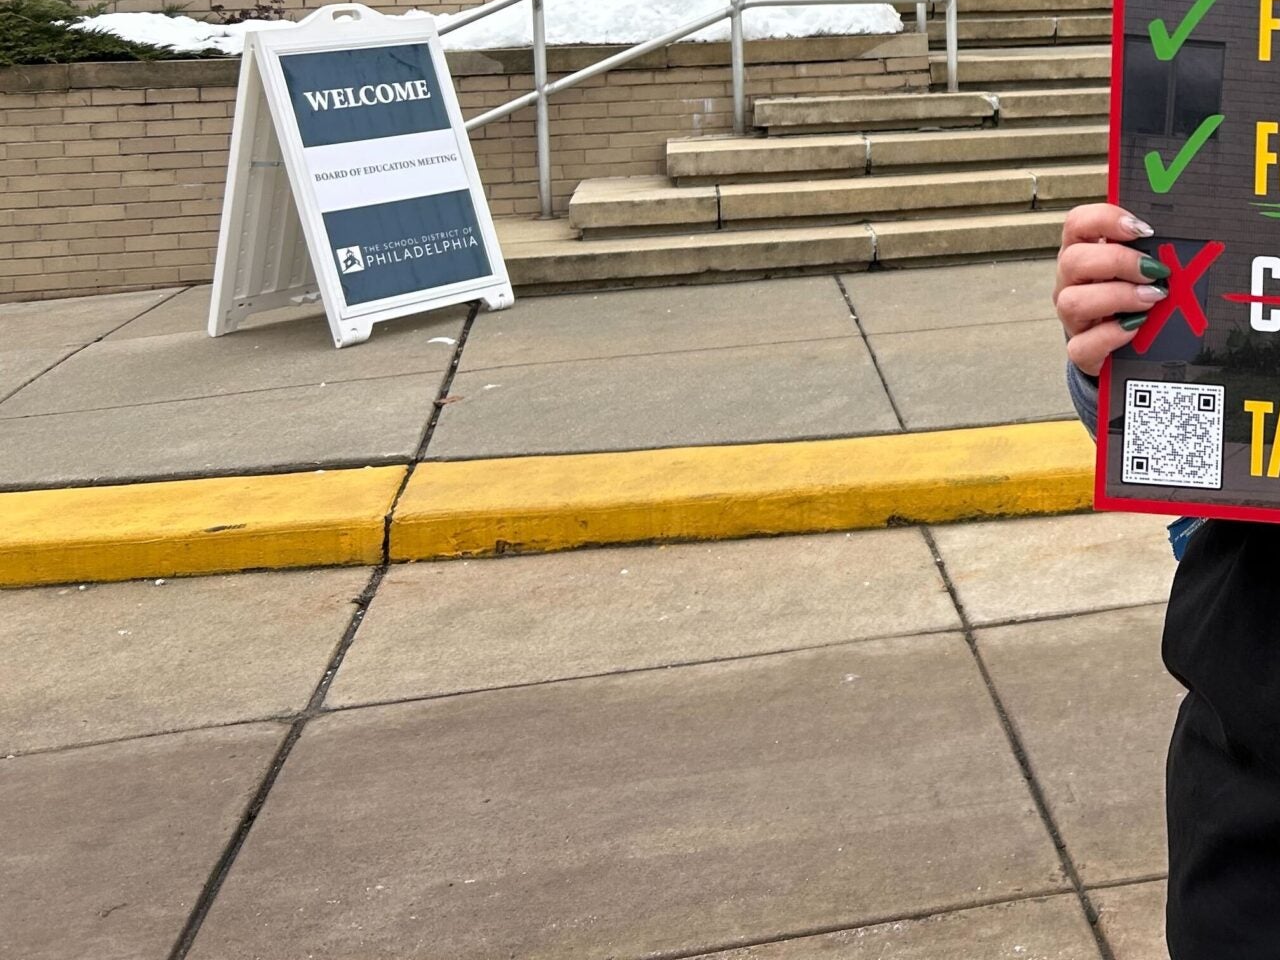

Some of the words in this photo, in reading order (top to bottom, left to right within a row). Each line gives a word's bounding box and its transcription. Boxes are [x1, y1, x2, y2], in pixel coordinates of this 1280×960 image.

[303, 80, 431, 111] WELCOME
[315, 170, 348, 182] BOARD
[349, 168, 362, 177] OF
[363, 160, 417, 175] EDUCATION
[417, 153, 458, 167] MEETING
[364, 244, 380, 253] THE
[383, 238, 419, 250] SCHOOL
[421, 229, 459, 243] DISTRICT
[462, 227, 472, 235] OF
[366, 236, 478, 267] PHILADELPHIA
